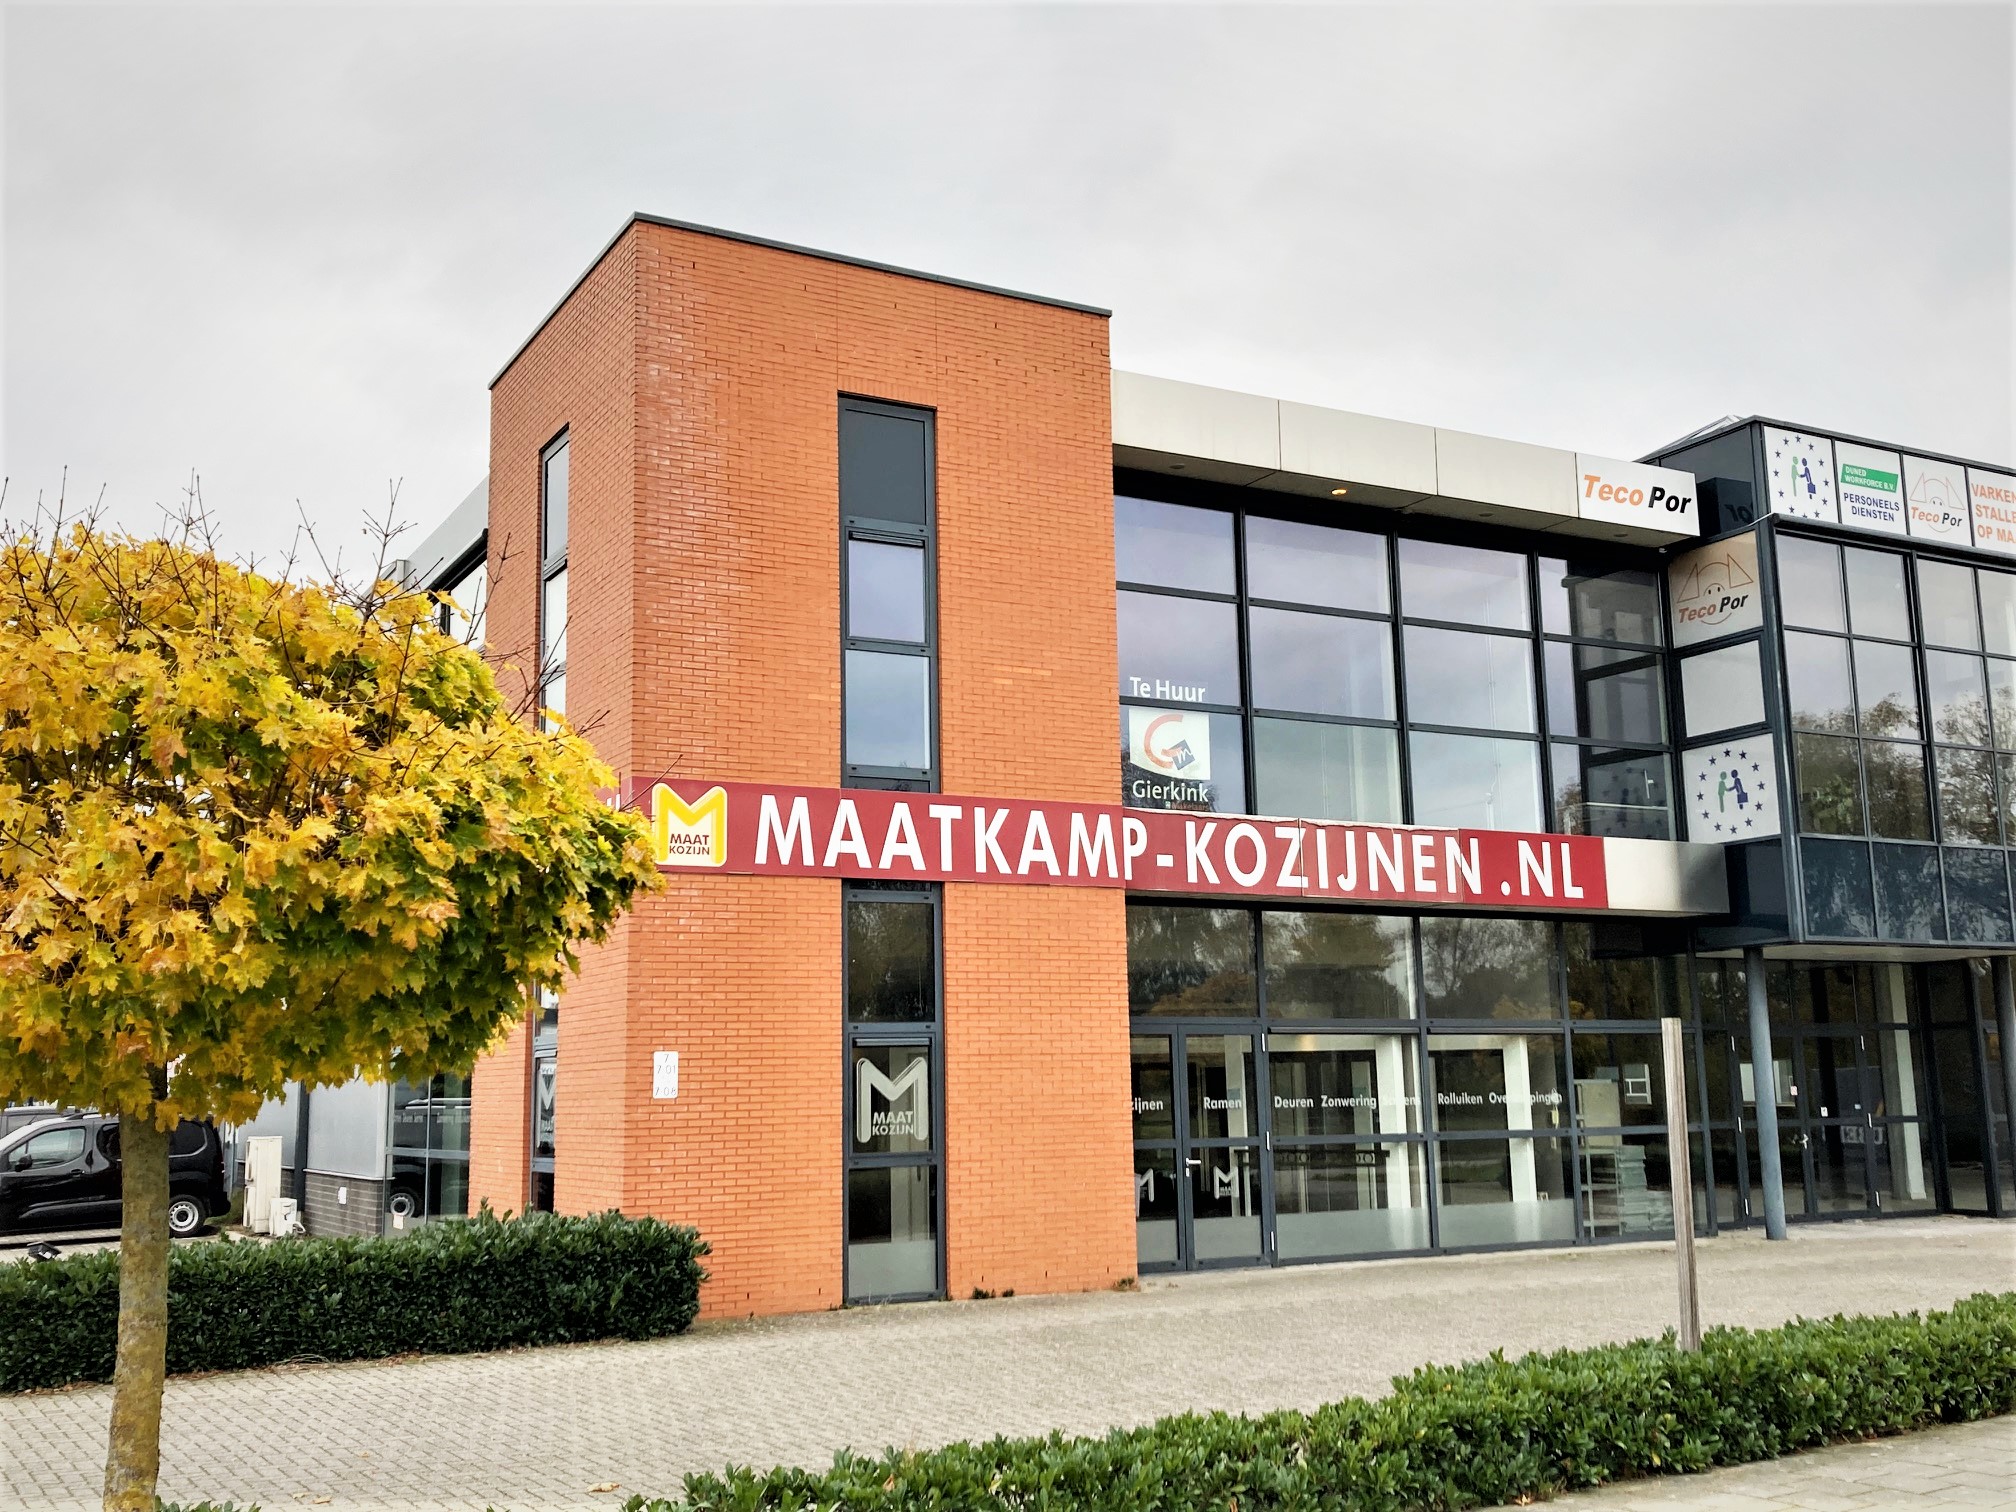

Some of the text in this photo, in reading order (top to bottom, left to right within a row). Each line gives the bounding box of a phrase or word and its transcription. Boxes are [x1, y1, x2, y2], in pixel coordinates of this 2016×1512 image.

[1845, 475, 1883, 489] WORKFORCE
[1583, 474, 1692, 514] Teco Por
[1843, 492, 1900, 512] PERSONEELS
[1851, 505, 1895, 522] DIENSTEN
[1911, 506, 1963, 528] Teco Por
[1977, 524, 2016, 545] OP MA
[1678, 594, 1749, 624] Teco Por
[1129, 676, 1206, 702] Te Huur
[1132, 779, 1209, 802] Gierkink
[669, 833, 710, 846] MAAT
[669, 845, 710, 856] KOZIJN
[1203, 1096, 1243, 1110] Ramen
[1274, 1095, 1314, 1109] Deuren
[1321, 1094, 1377, 1112] Zonwering
[1438, 1092, 1484, 1105] Rolluiken
[1488, 1090, 1563, 1106] Ovepingn
[873, 1111, 914, 1125] MAAT
[872, 1124, 914, 1136] KOZIJN
